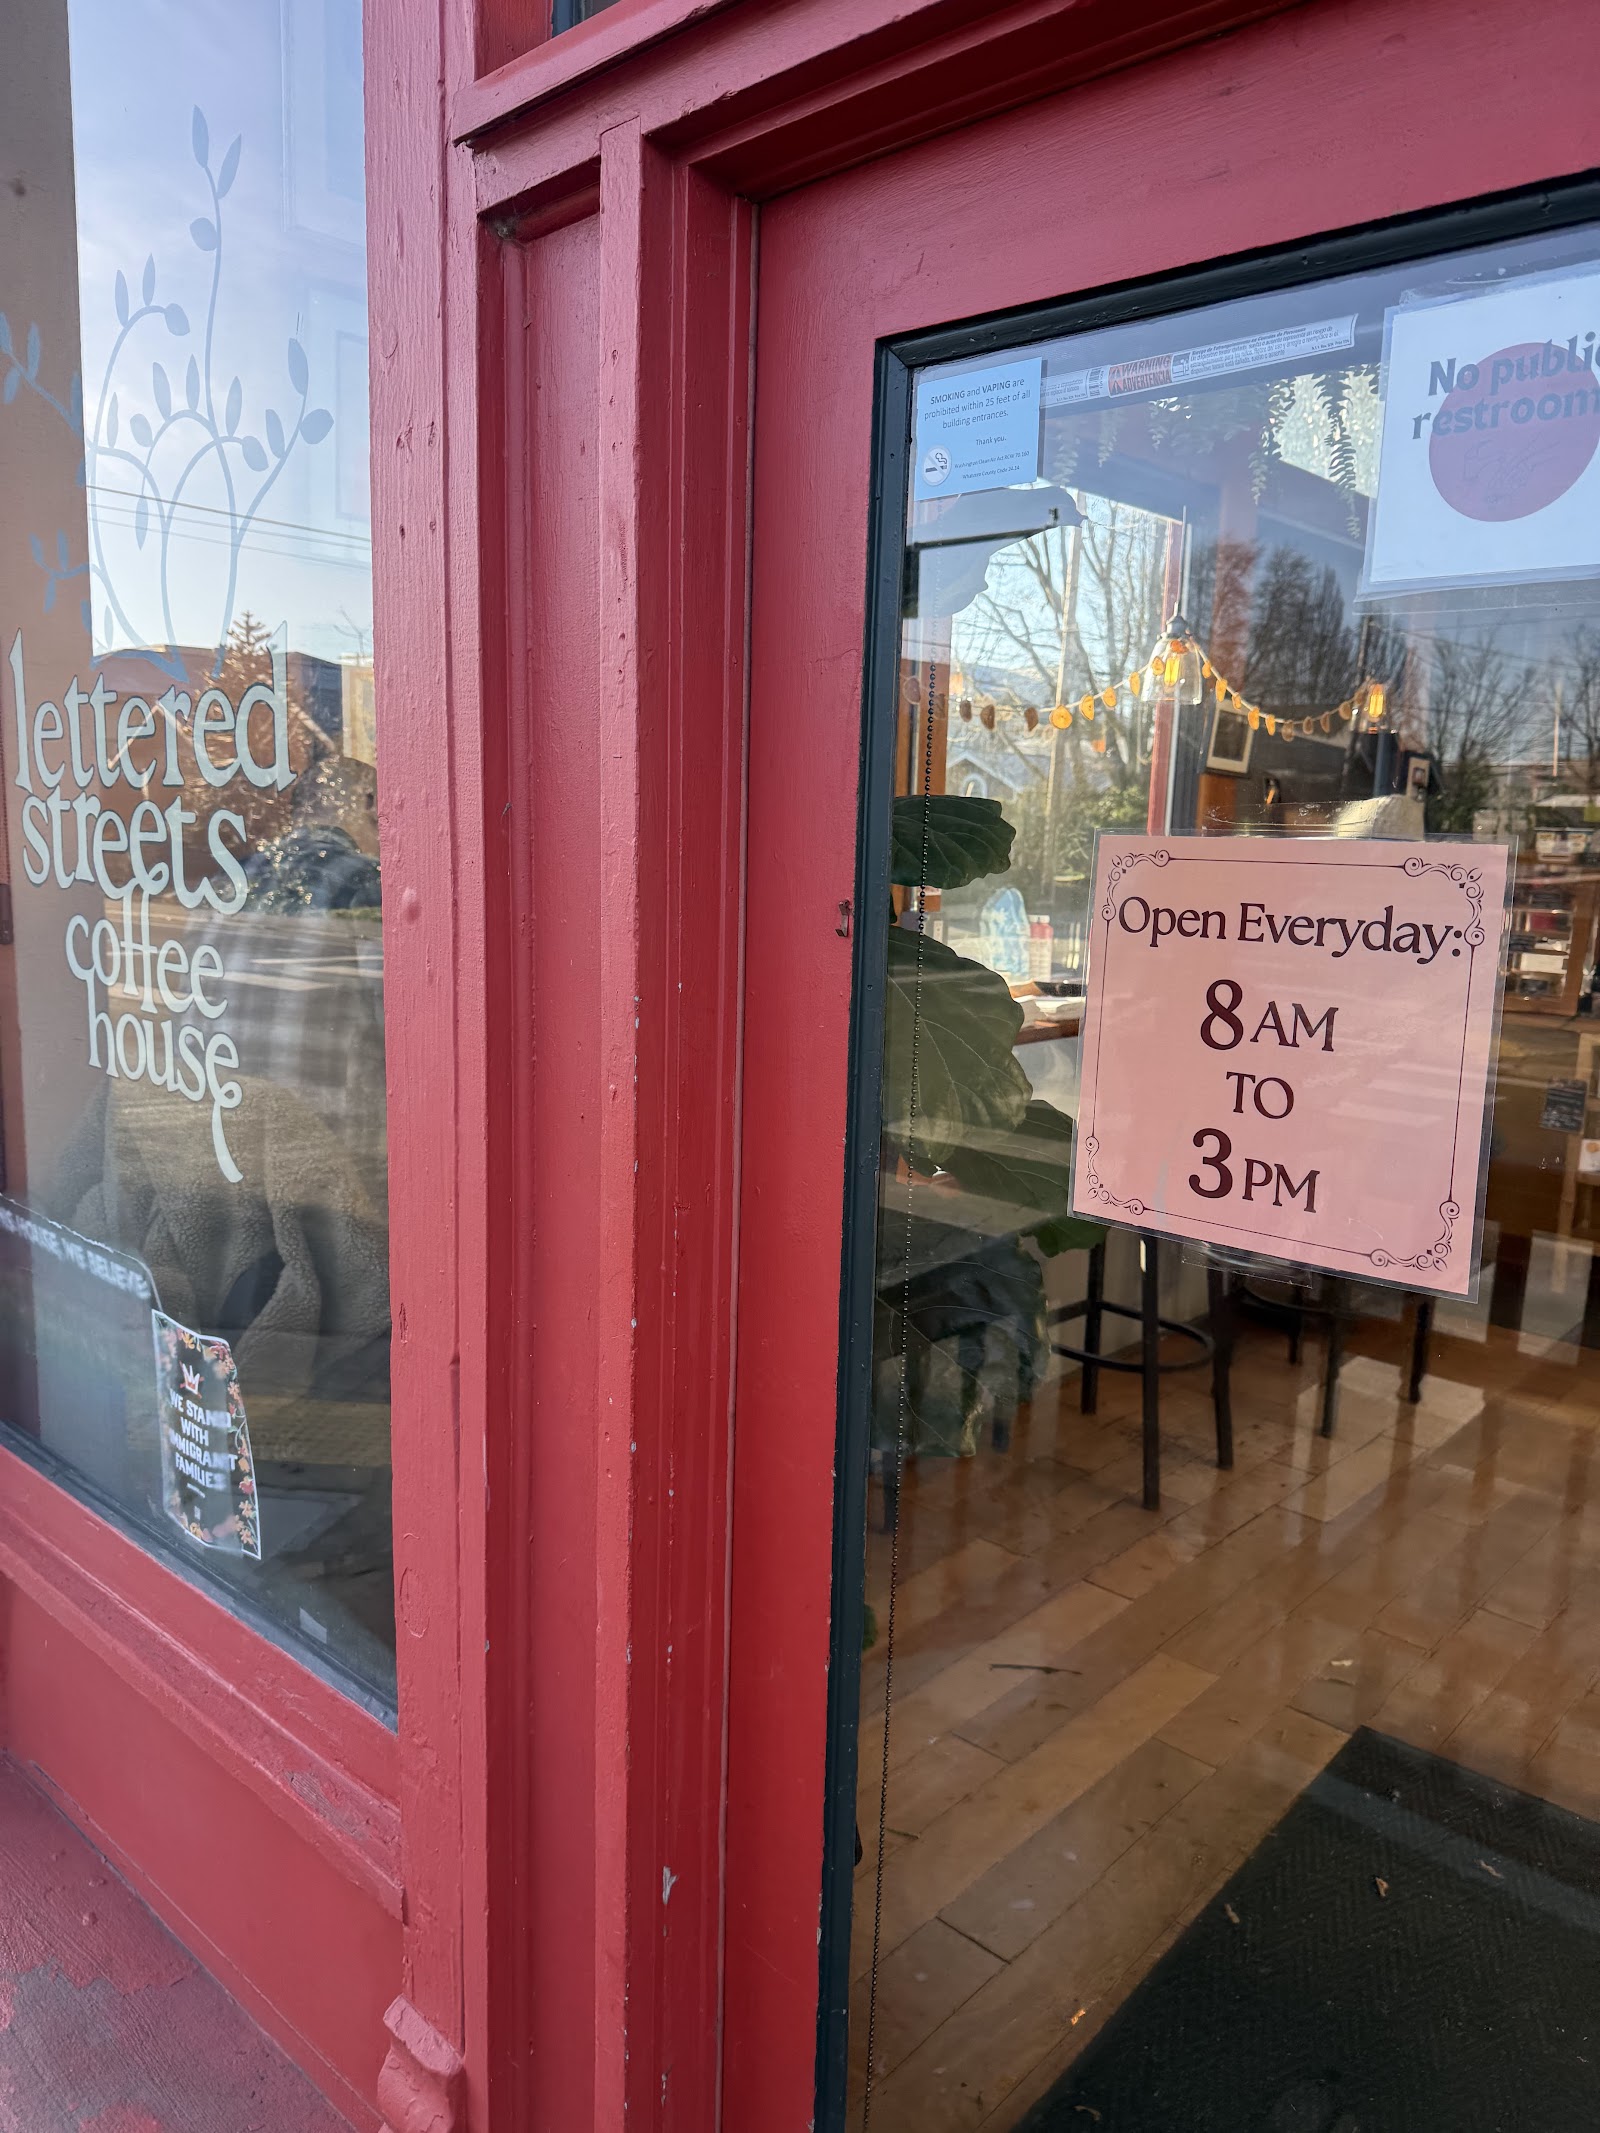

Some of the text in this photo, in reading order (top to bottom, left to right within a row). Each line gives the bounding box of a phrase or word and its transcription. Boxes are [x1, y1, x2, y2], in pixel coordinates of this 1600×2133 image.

[1122, 355, 1171, 377] WARNING
[1122, 369, 1172, 391] ADVERTENCIA
[1428, 358, 1479, 396] No
[924, 390, 1031, 421] prohibited within 25 feet of all
[930, 378, 1025, 405] SMOKING and VAPING are
[942, 409, 1009, 429] building entrances.
[976, 436, 1007, 446] Thank you.
[9, 620, 298, 793] lettered
[22, 785, 249, 915] streets
[1118, 896, 1464, 965] Open Everyday:
[65, 885, 229, 1020] coffee
[87, 968, 245, 1184] house
[1225, 1070, 1295, 1120] TO
[1188, 1128, 1321, 1214] 3 PM
[169, 1388, 232, 1428] WE STAND
[168, 1428, 238, 1472] IMMIGRANT
[180, 1416, 210, 1447] WITH
[174, 1451, 229, 1490] FAMILIES
